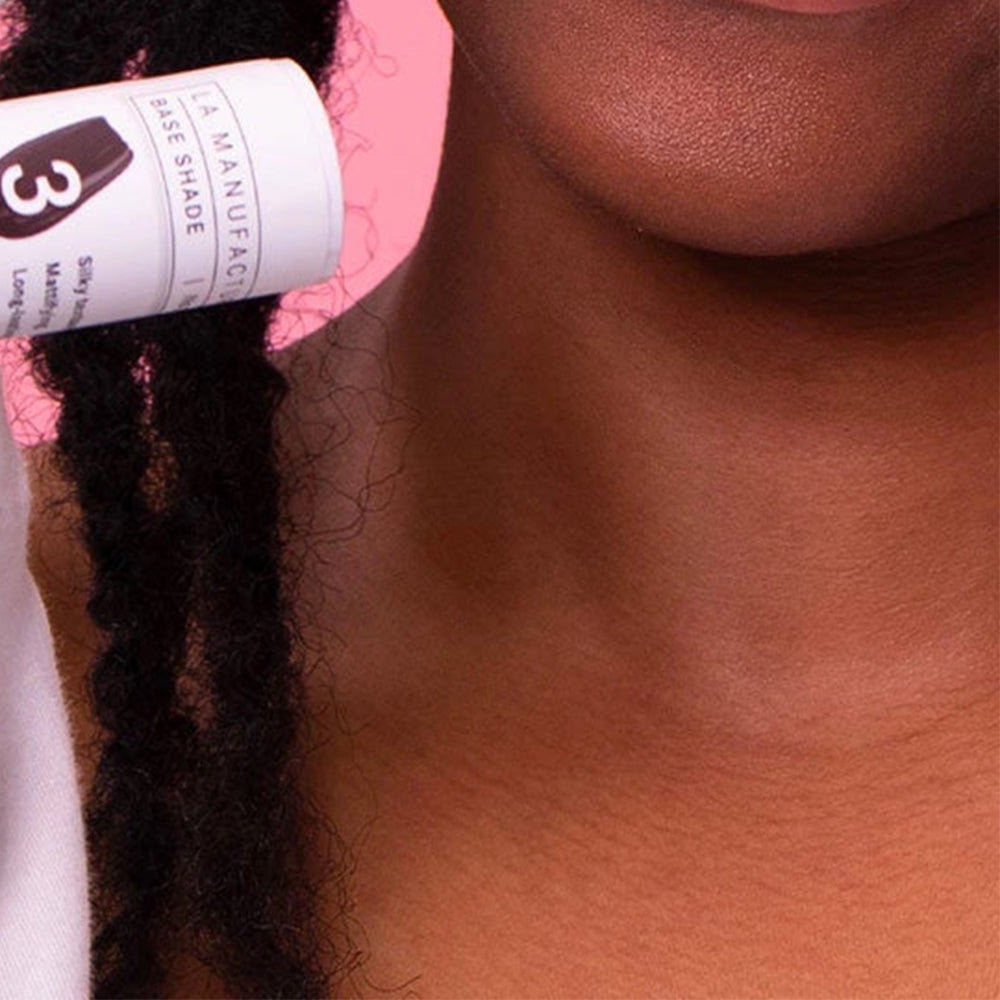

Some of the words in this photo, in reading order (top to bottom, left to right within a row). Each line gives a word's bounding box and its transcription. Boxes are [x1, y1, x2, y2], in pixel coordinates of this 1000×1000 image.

[191, 90, 220, 118] LA
[1, 159, 83, 217] 3
[149, 97, 187, 145] BASE
[174, 153, 205, 236] SHADE
